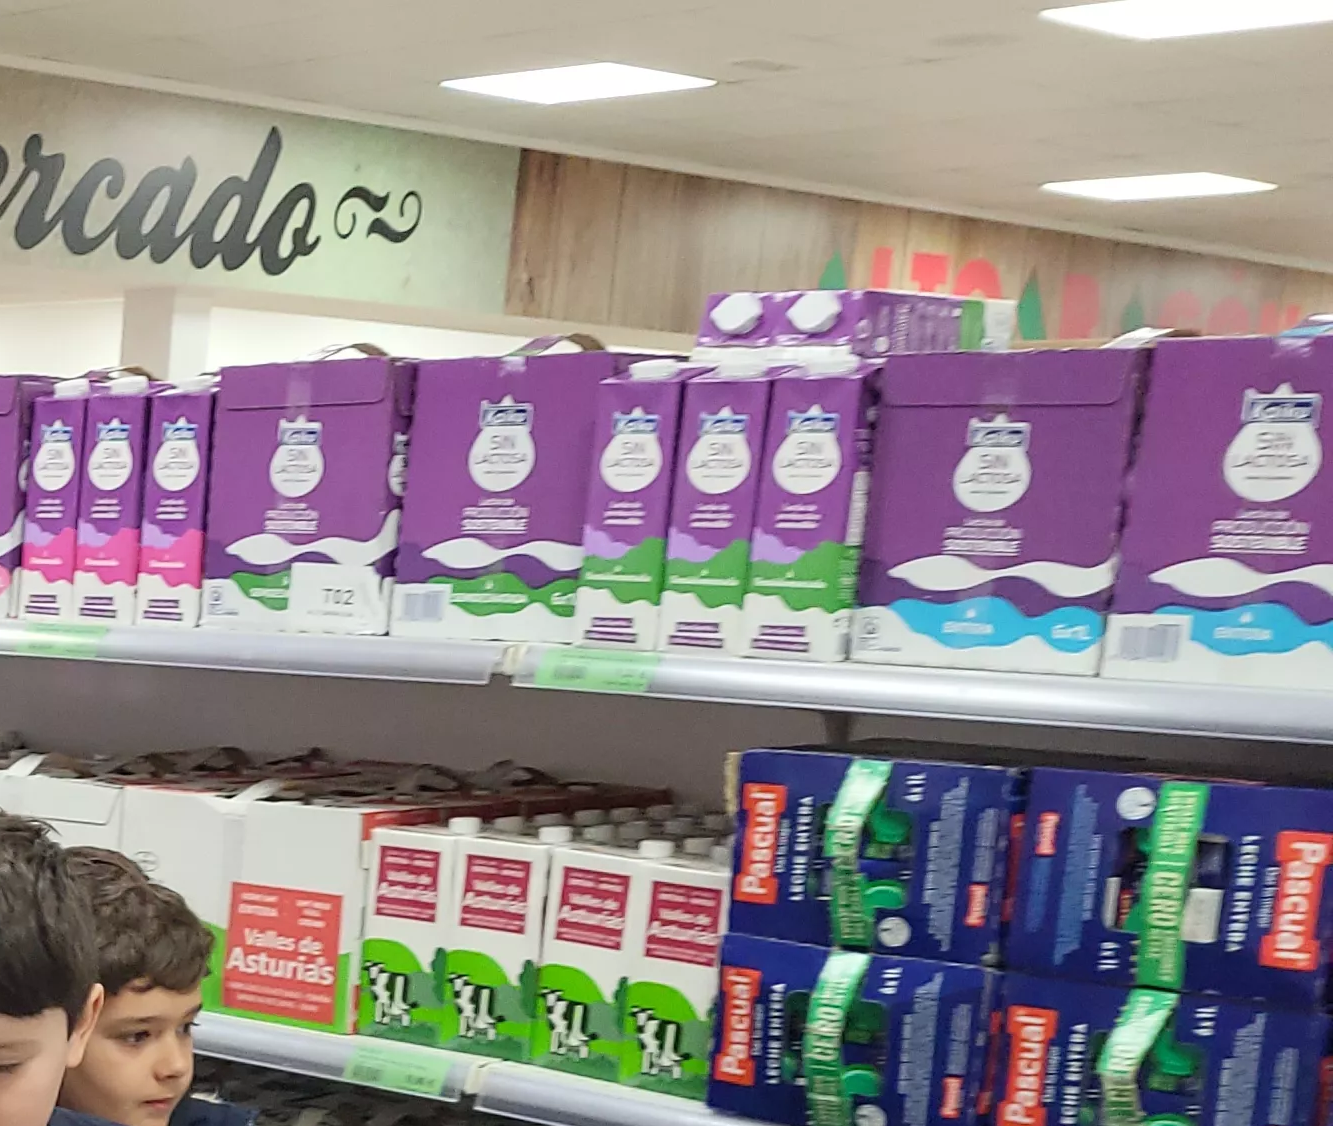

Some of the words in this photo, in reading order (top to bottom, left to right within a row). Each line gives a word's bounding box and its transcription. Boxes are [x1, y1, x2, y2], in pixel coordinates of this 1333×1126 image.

[741, 790, 777, 896] Pascual
[243, 927, 296, 951] Valles
[298, 936, 324, 955] de
[1272, 840, 1325, 961] Pascual
[225, 947, 335, 985] Asturias
[720, 974, 752, 1076] Pascual
[1003, 1015, 1047, 1126] Pascual
